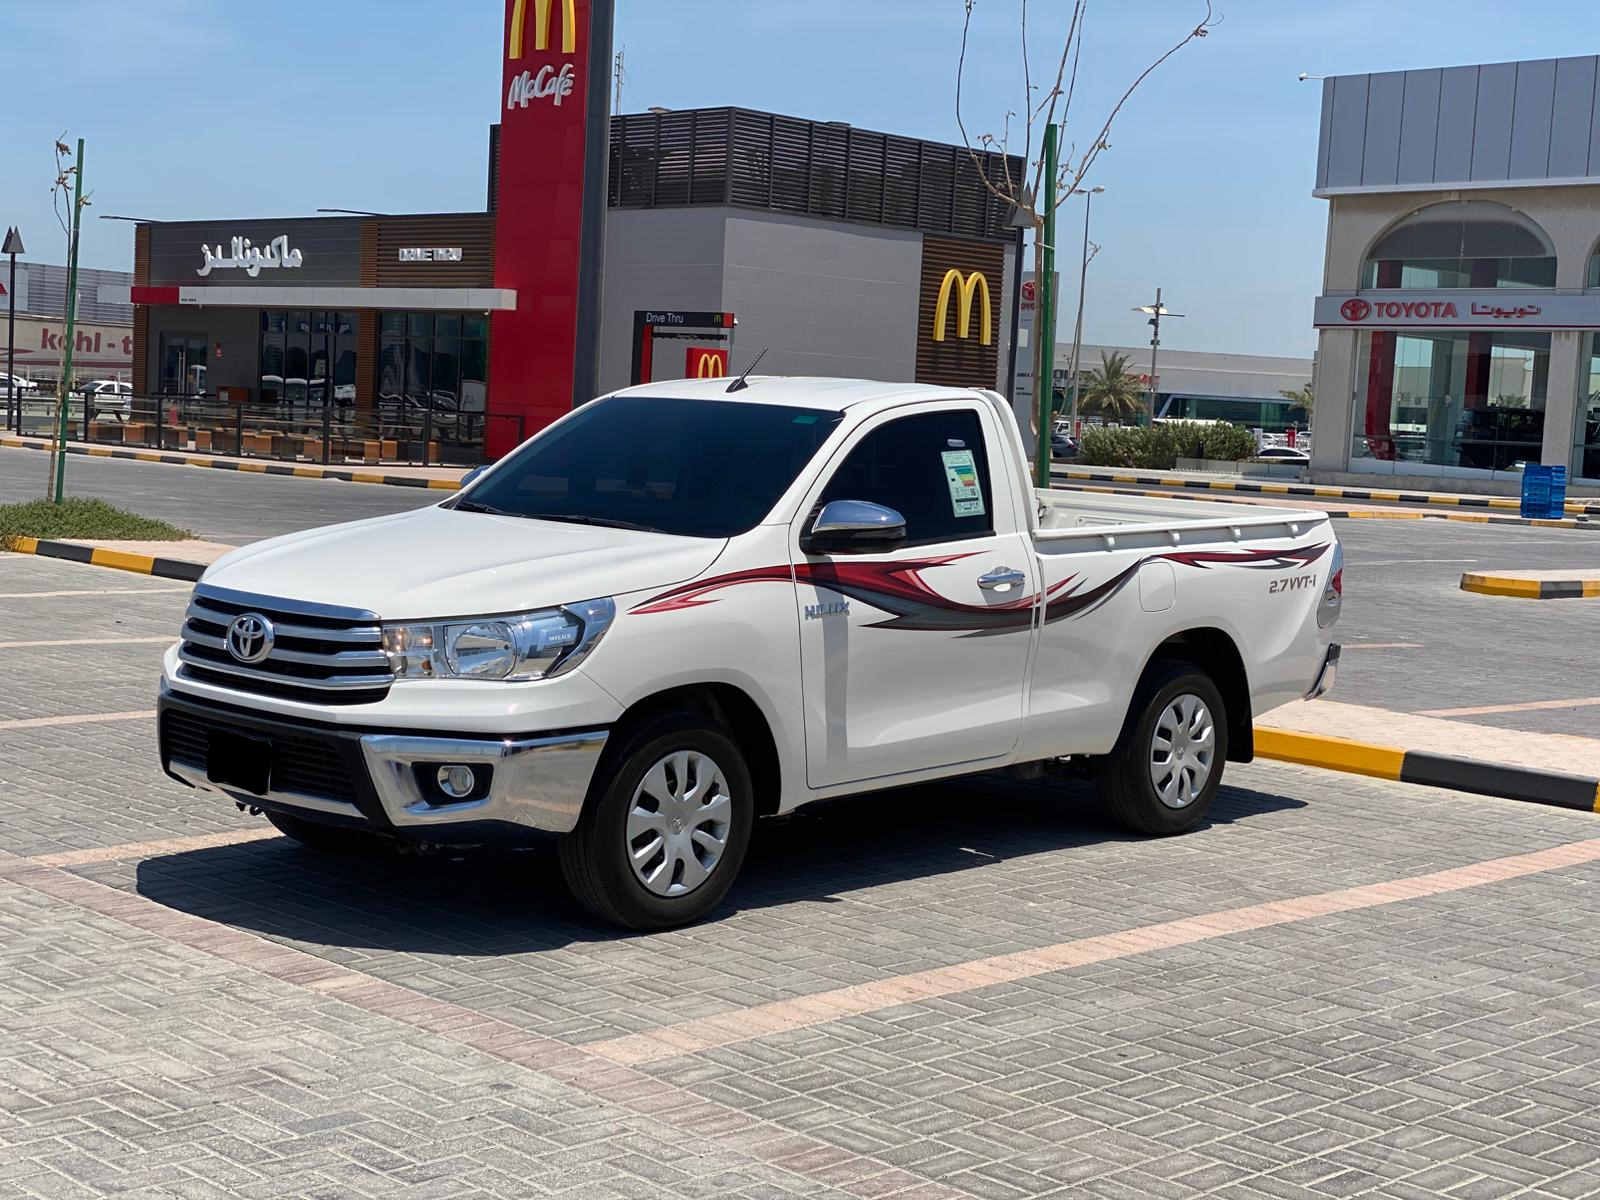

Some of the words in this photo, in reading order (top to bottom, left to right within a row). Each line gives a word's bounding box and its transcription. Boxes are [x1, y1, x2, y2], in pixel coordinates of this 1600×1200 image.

[506, 63, 576, 110] McCafé
[196, 235, 303, 277] ماكدونالدز
[646, 312, 665, 323] Drive
[666, 313, 684, 324] Thru
[1373, 301, 1458, 319] TOYOTA
[1471, 301, 1542, 319] تويوتا
[803, 601, 850, 621] HILUX
